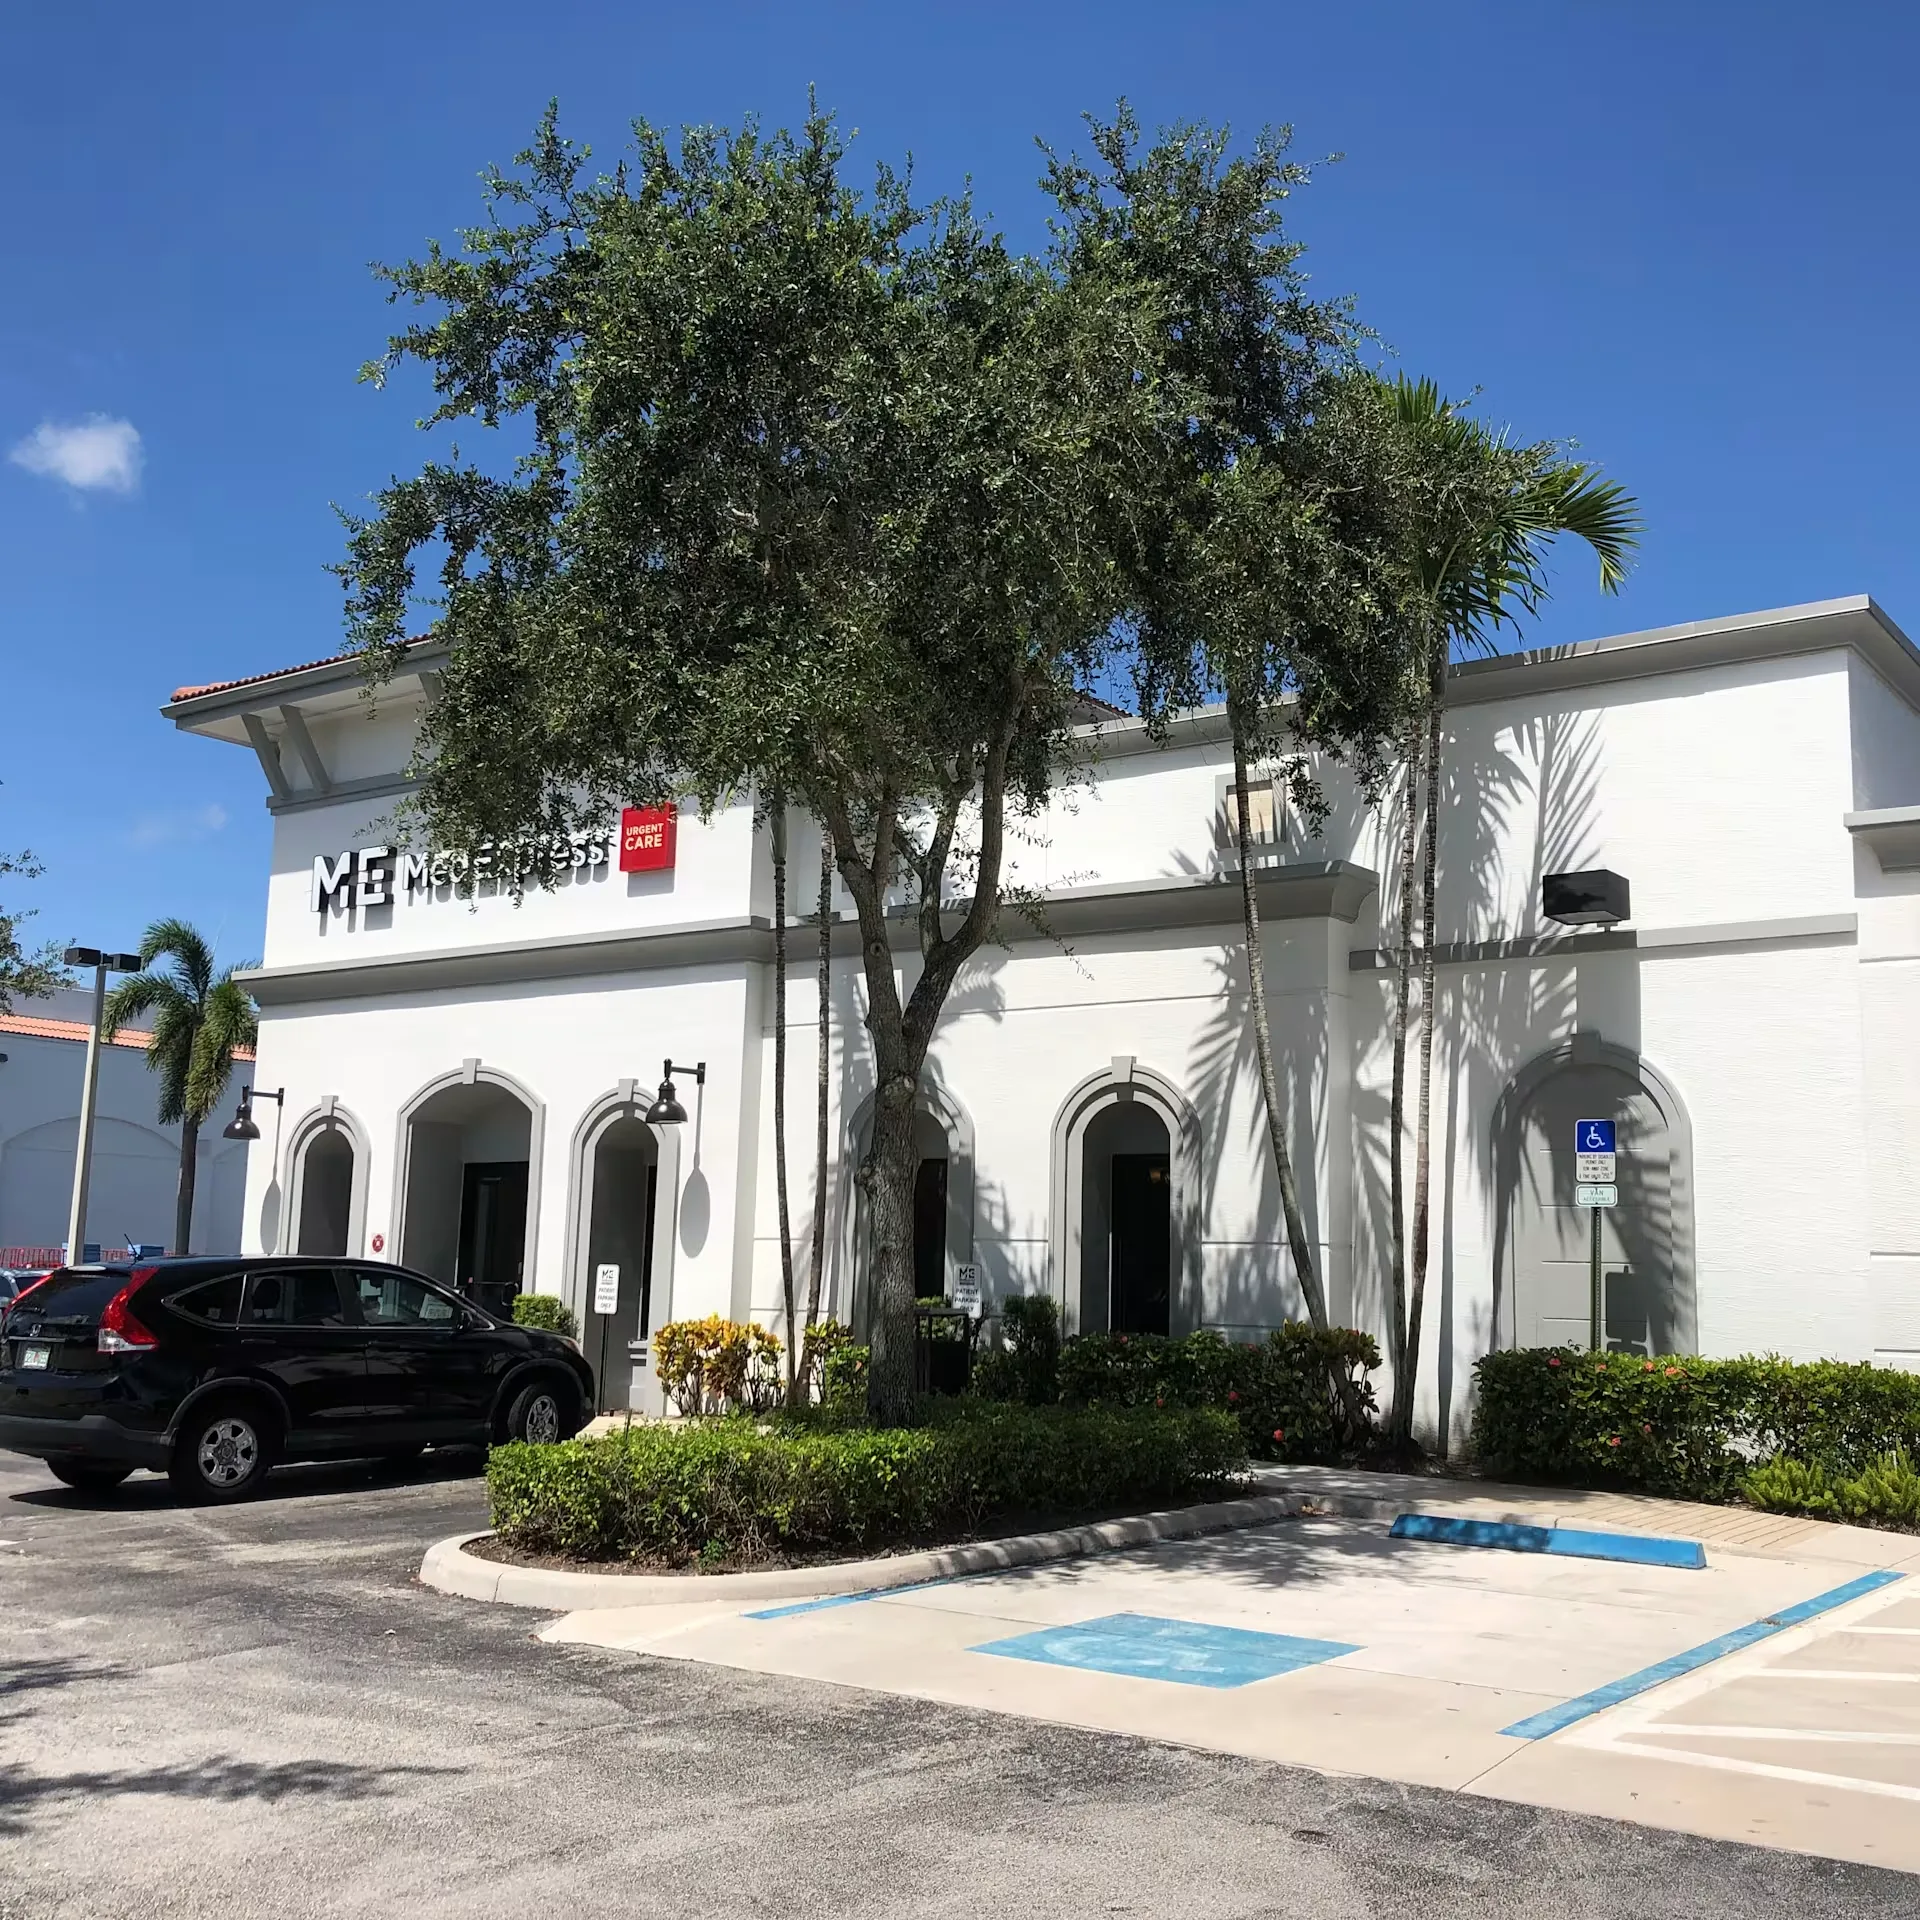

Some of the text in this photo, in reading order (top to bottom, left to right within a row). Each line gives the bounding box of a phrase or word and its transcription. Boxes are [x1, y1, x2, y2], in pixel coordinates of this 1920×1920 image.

[626, 823, 664, 836] URGENT
[625, 833, 663, 850] CARE
[311, 846, 396, 912] ME
